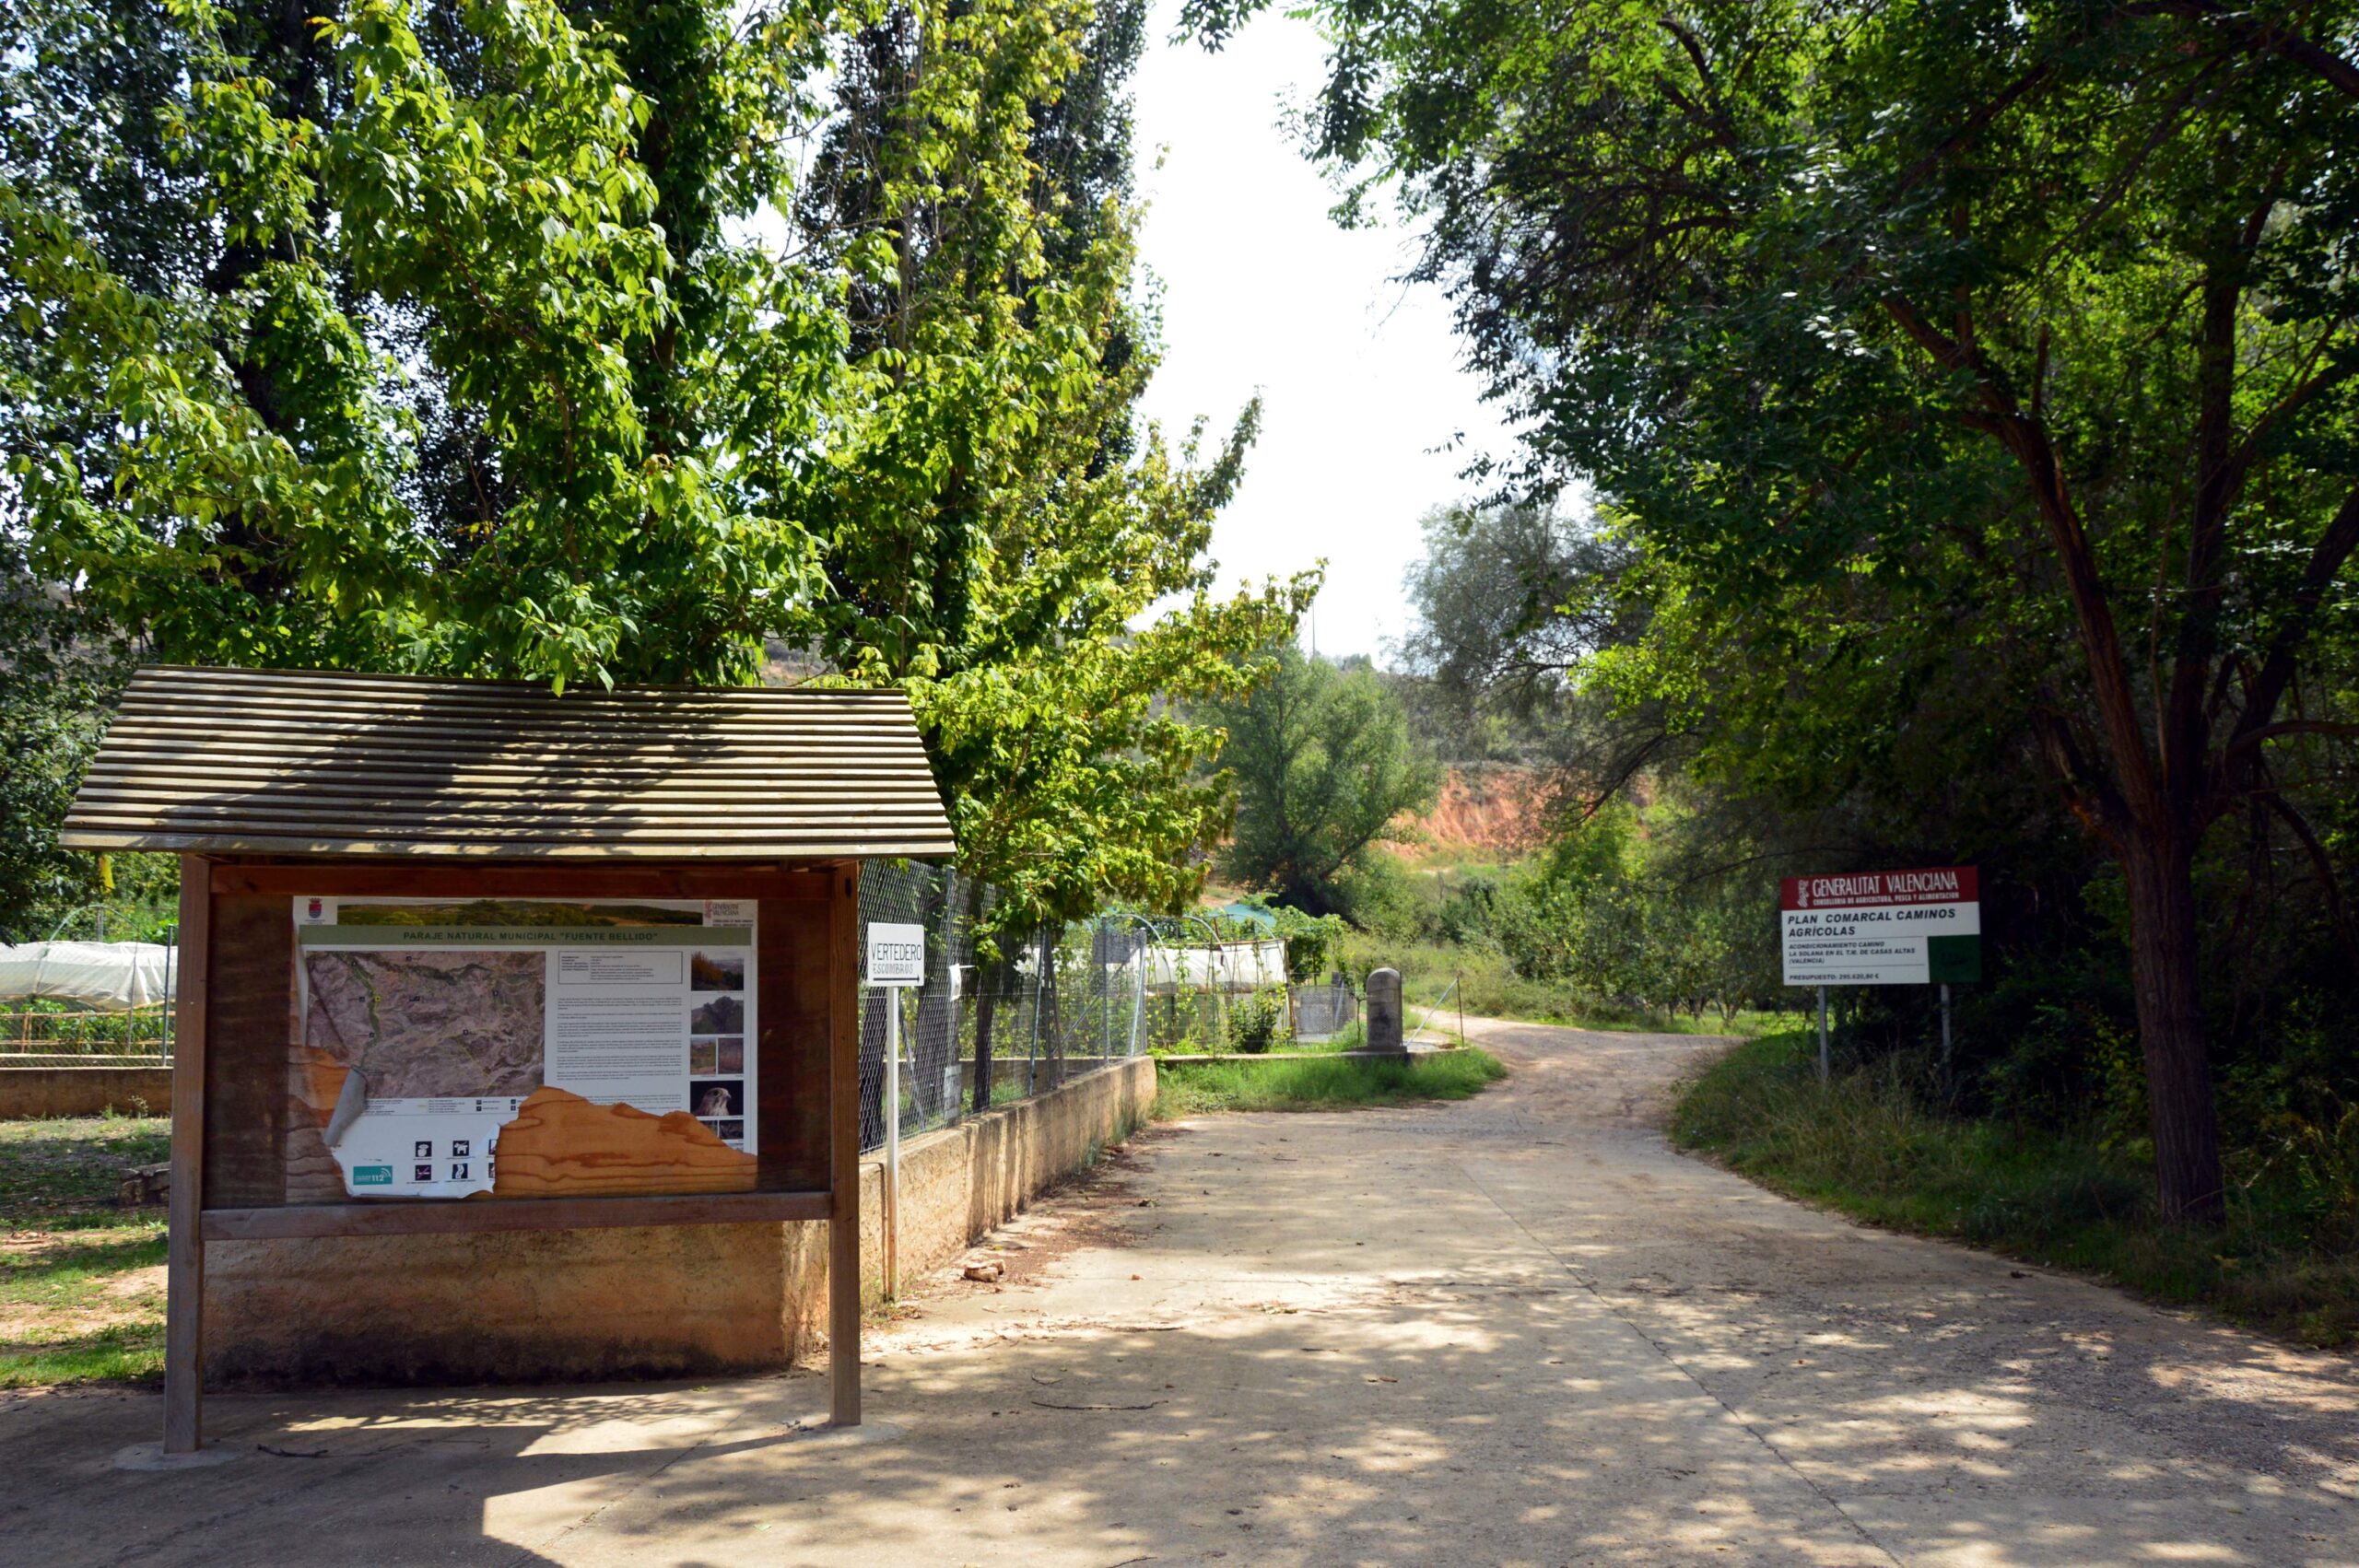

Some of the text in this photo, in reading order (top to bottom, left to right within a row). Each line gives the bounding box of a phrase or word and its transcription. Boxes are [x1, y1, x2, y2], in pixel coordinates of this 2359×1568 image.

[1813, 871, 1958, 897] GENERALITAT VALENCIANA
[1895, 894, 1911, 902] PESCA
[1788, 908, 1955, 925] PLAN COMARCAL CAMINOS
[404, 931, 658, 941] PARAJE NATURAL MUNICIPAL "FUENTE BELLIDO"
[1789, 926, 1856, 937] AGRÍCOLAS
[871, 942, 922, 961] VERTEDERO
[1789, 942, 1857, 950] ACONDICIONAMIENTO
[873, 963, 913, 975] ESCOMBROS
